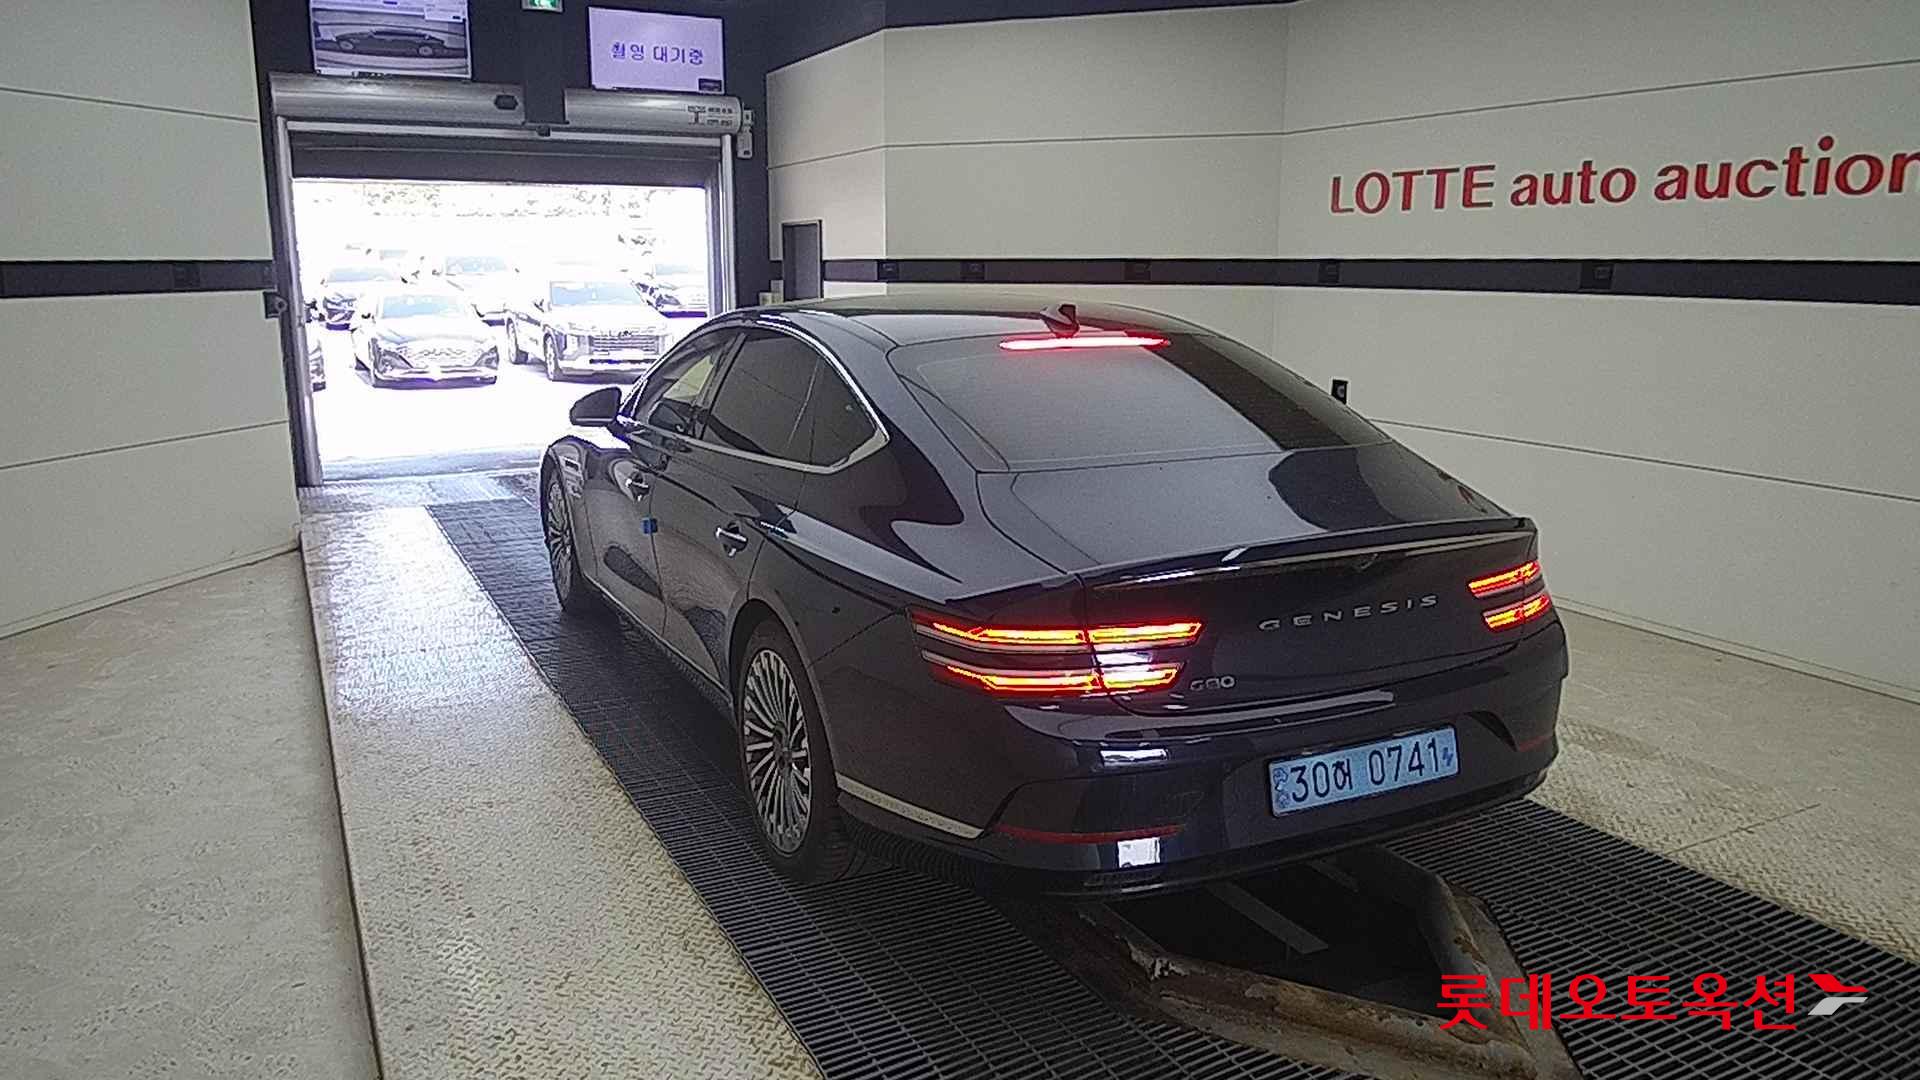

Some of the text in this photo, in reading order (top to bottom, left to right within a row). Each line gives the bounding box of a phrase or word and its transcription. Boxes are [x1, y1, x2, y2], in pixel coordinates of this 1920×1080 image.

[653, 45, 704, 66] 대기중
[1330, 164, 1497, 214] LOTTE
[1510, 160, 1637, 207] auto
[1259, 595, 1438, 632] GENESIS
[1368, 737, 1439, 786] 0741
